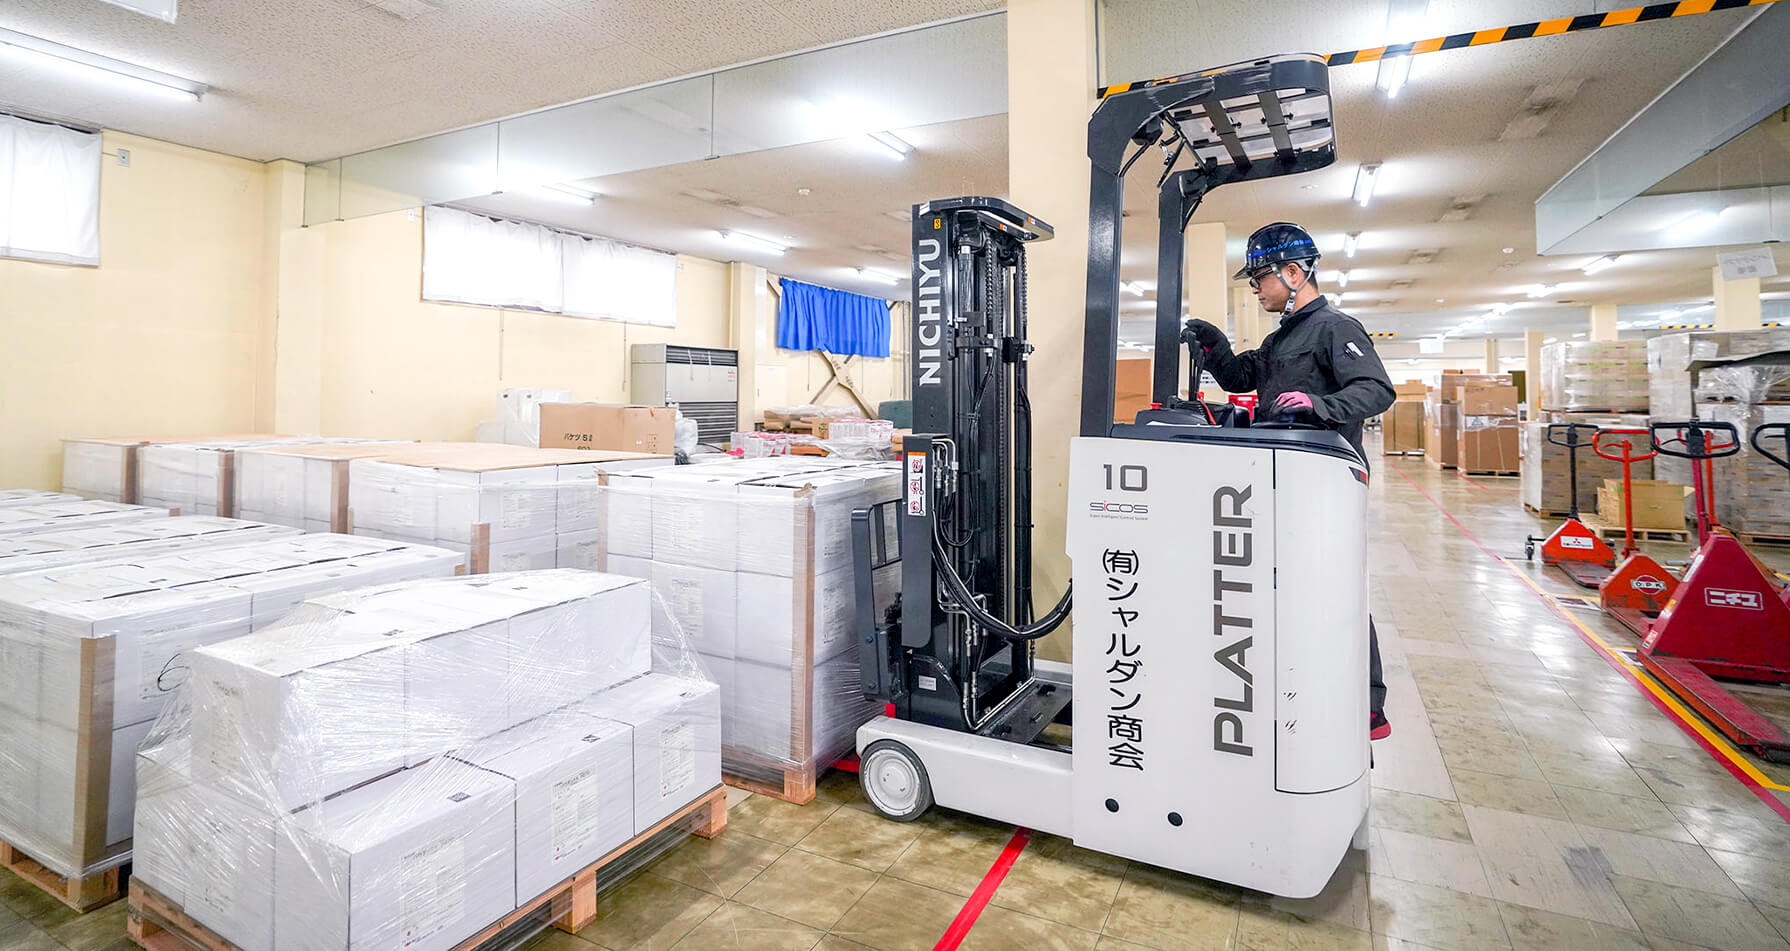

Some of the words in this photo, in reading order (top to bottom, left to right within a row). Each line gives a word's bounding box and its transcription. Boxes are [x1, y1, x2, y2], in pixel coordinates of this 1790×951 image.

[919, 238, 941, 386] NICHIYU
[1103, 464, 1147, 491] 10
[1213, 484, 1253, 757] PLATTER
